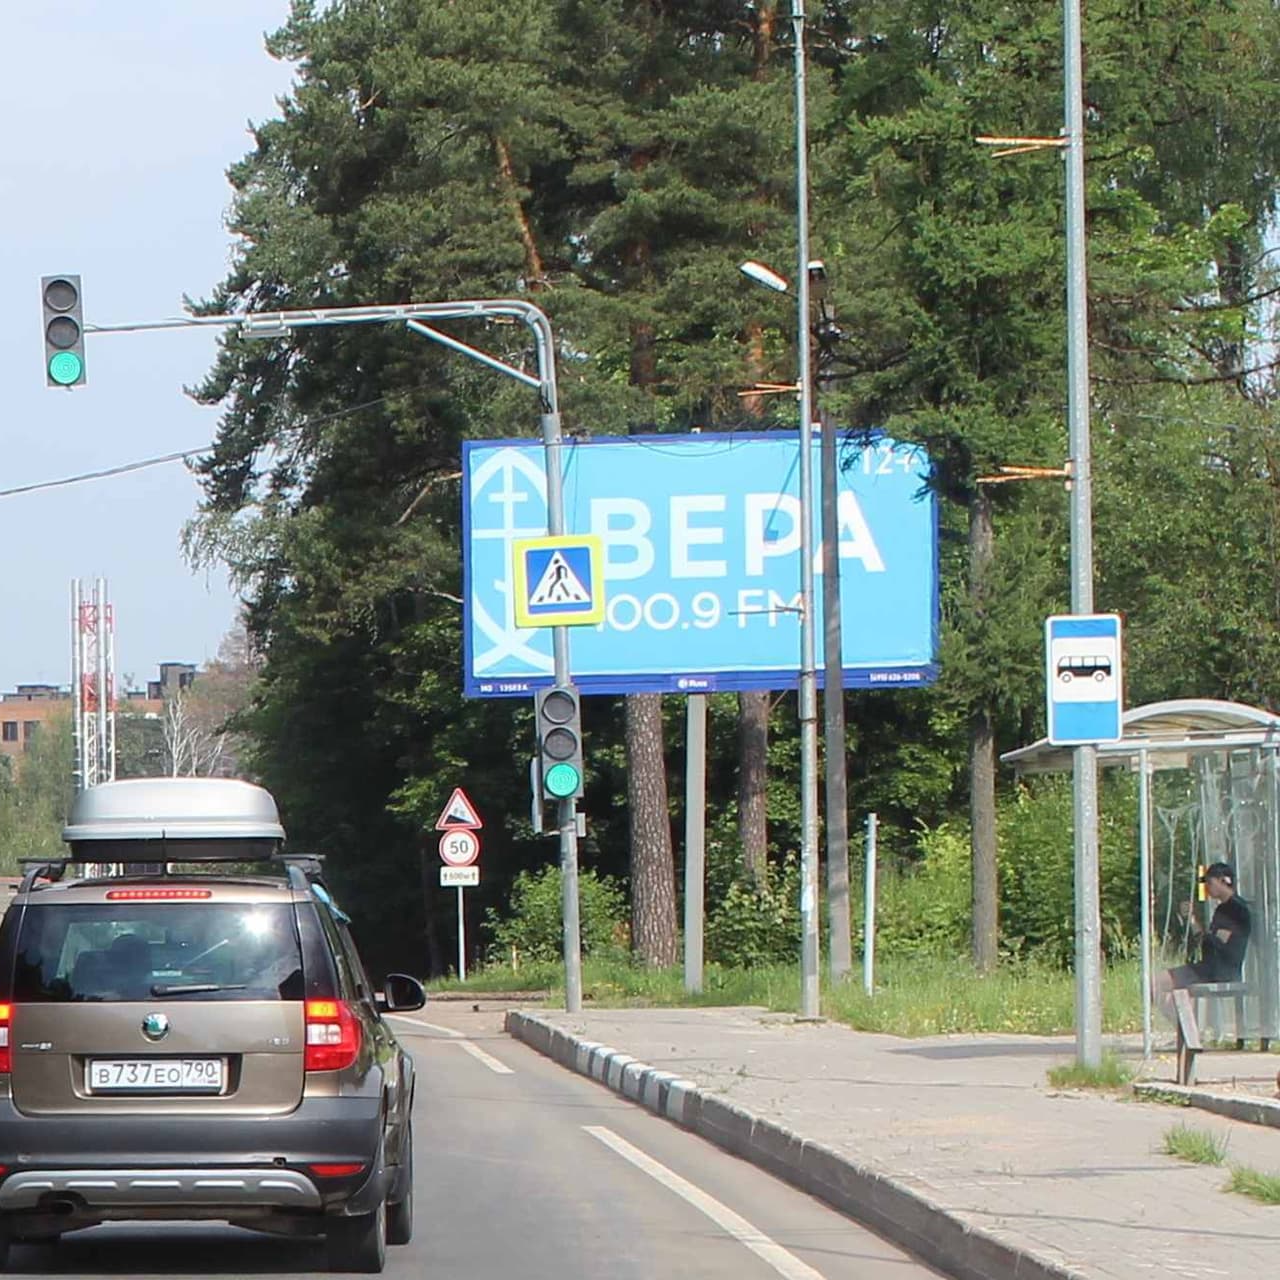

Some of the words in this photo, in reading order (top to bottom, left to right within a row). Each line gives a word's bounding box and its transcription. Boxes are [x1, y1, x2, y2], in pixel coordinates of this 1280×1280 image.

[590, 490, 886, 581] ВЕРА
[595, 591, 720, 632] 00.9
[450, 840, 469, 855] 50
